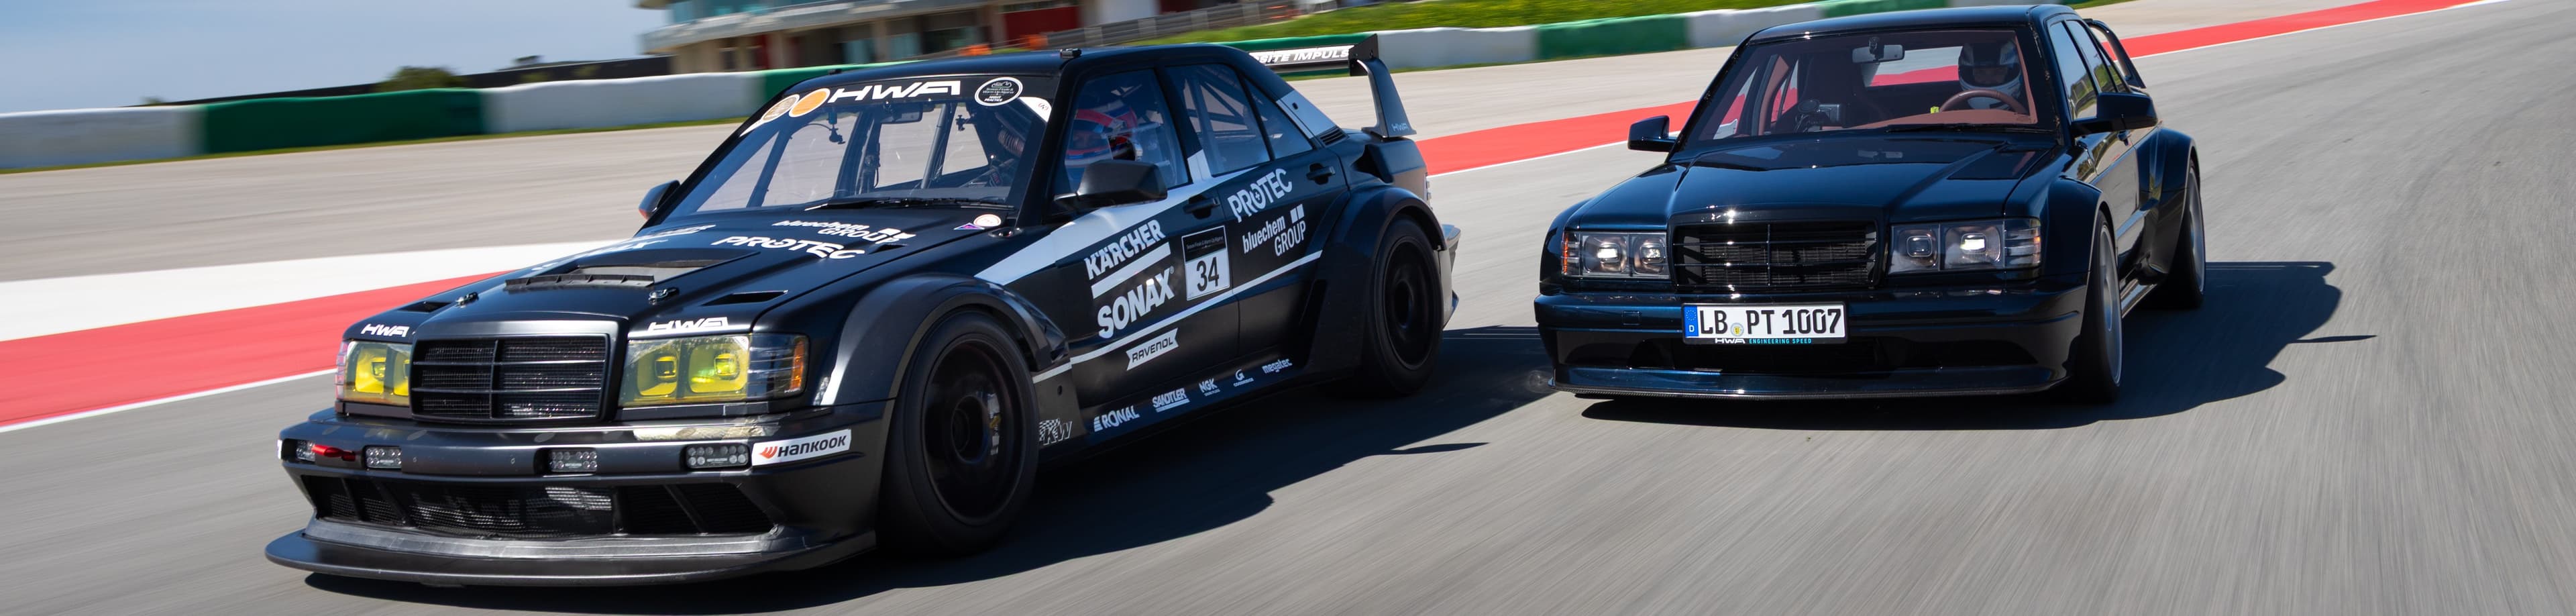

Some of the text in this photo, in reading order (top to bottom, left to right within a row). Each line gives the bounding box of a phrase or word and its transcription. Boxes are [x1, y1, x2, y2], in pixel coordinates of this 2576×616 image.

[1293, 49, 1349, 61] IMPULS
[828, 80, 961, 103] HWA
[1228, 168, 1292, 223] PROTEC
[818, 228, 900, 244] GROUP
[1243, 216, 1286, 254] bluechem
[1275, 220, 1306, 257] GROUP
[710, 236, 865, 259] PROTEC
[1084, 219, 1166, 280] KÄRCHER
[1196, 256, 1220, 291] 34
[1097, 268, 1175, 339] SONAX
[360, 323, 410, 338] HWA
[647, 317, 729, 331] HWA
[1700, 309, 1841, 334] LB PT 1007
[1132, 338, 1173, 363] RAVENOL
[1261, 358, 1292, 374] megatec
[1198, 378, 1218, 393] NGK
[1152, 388, 1187, 409] SANDTLER
[1102, 405, 1140, 428] RONAL
